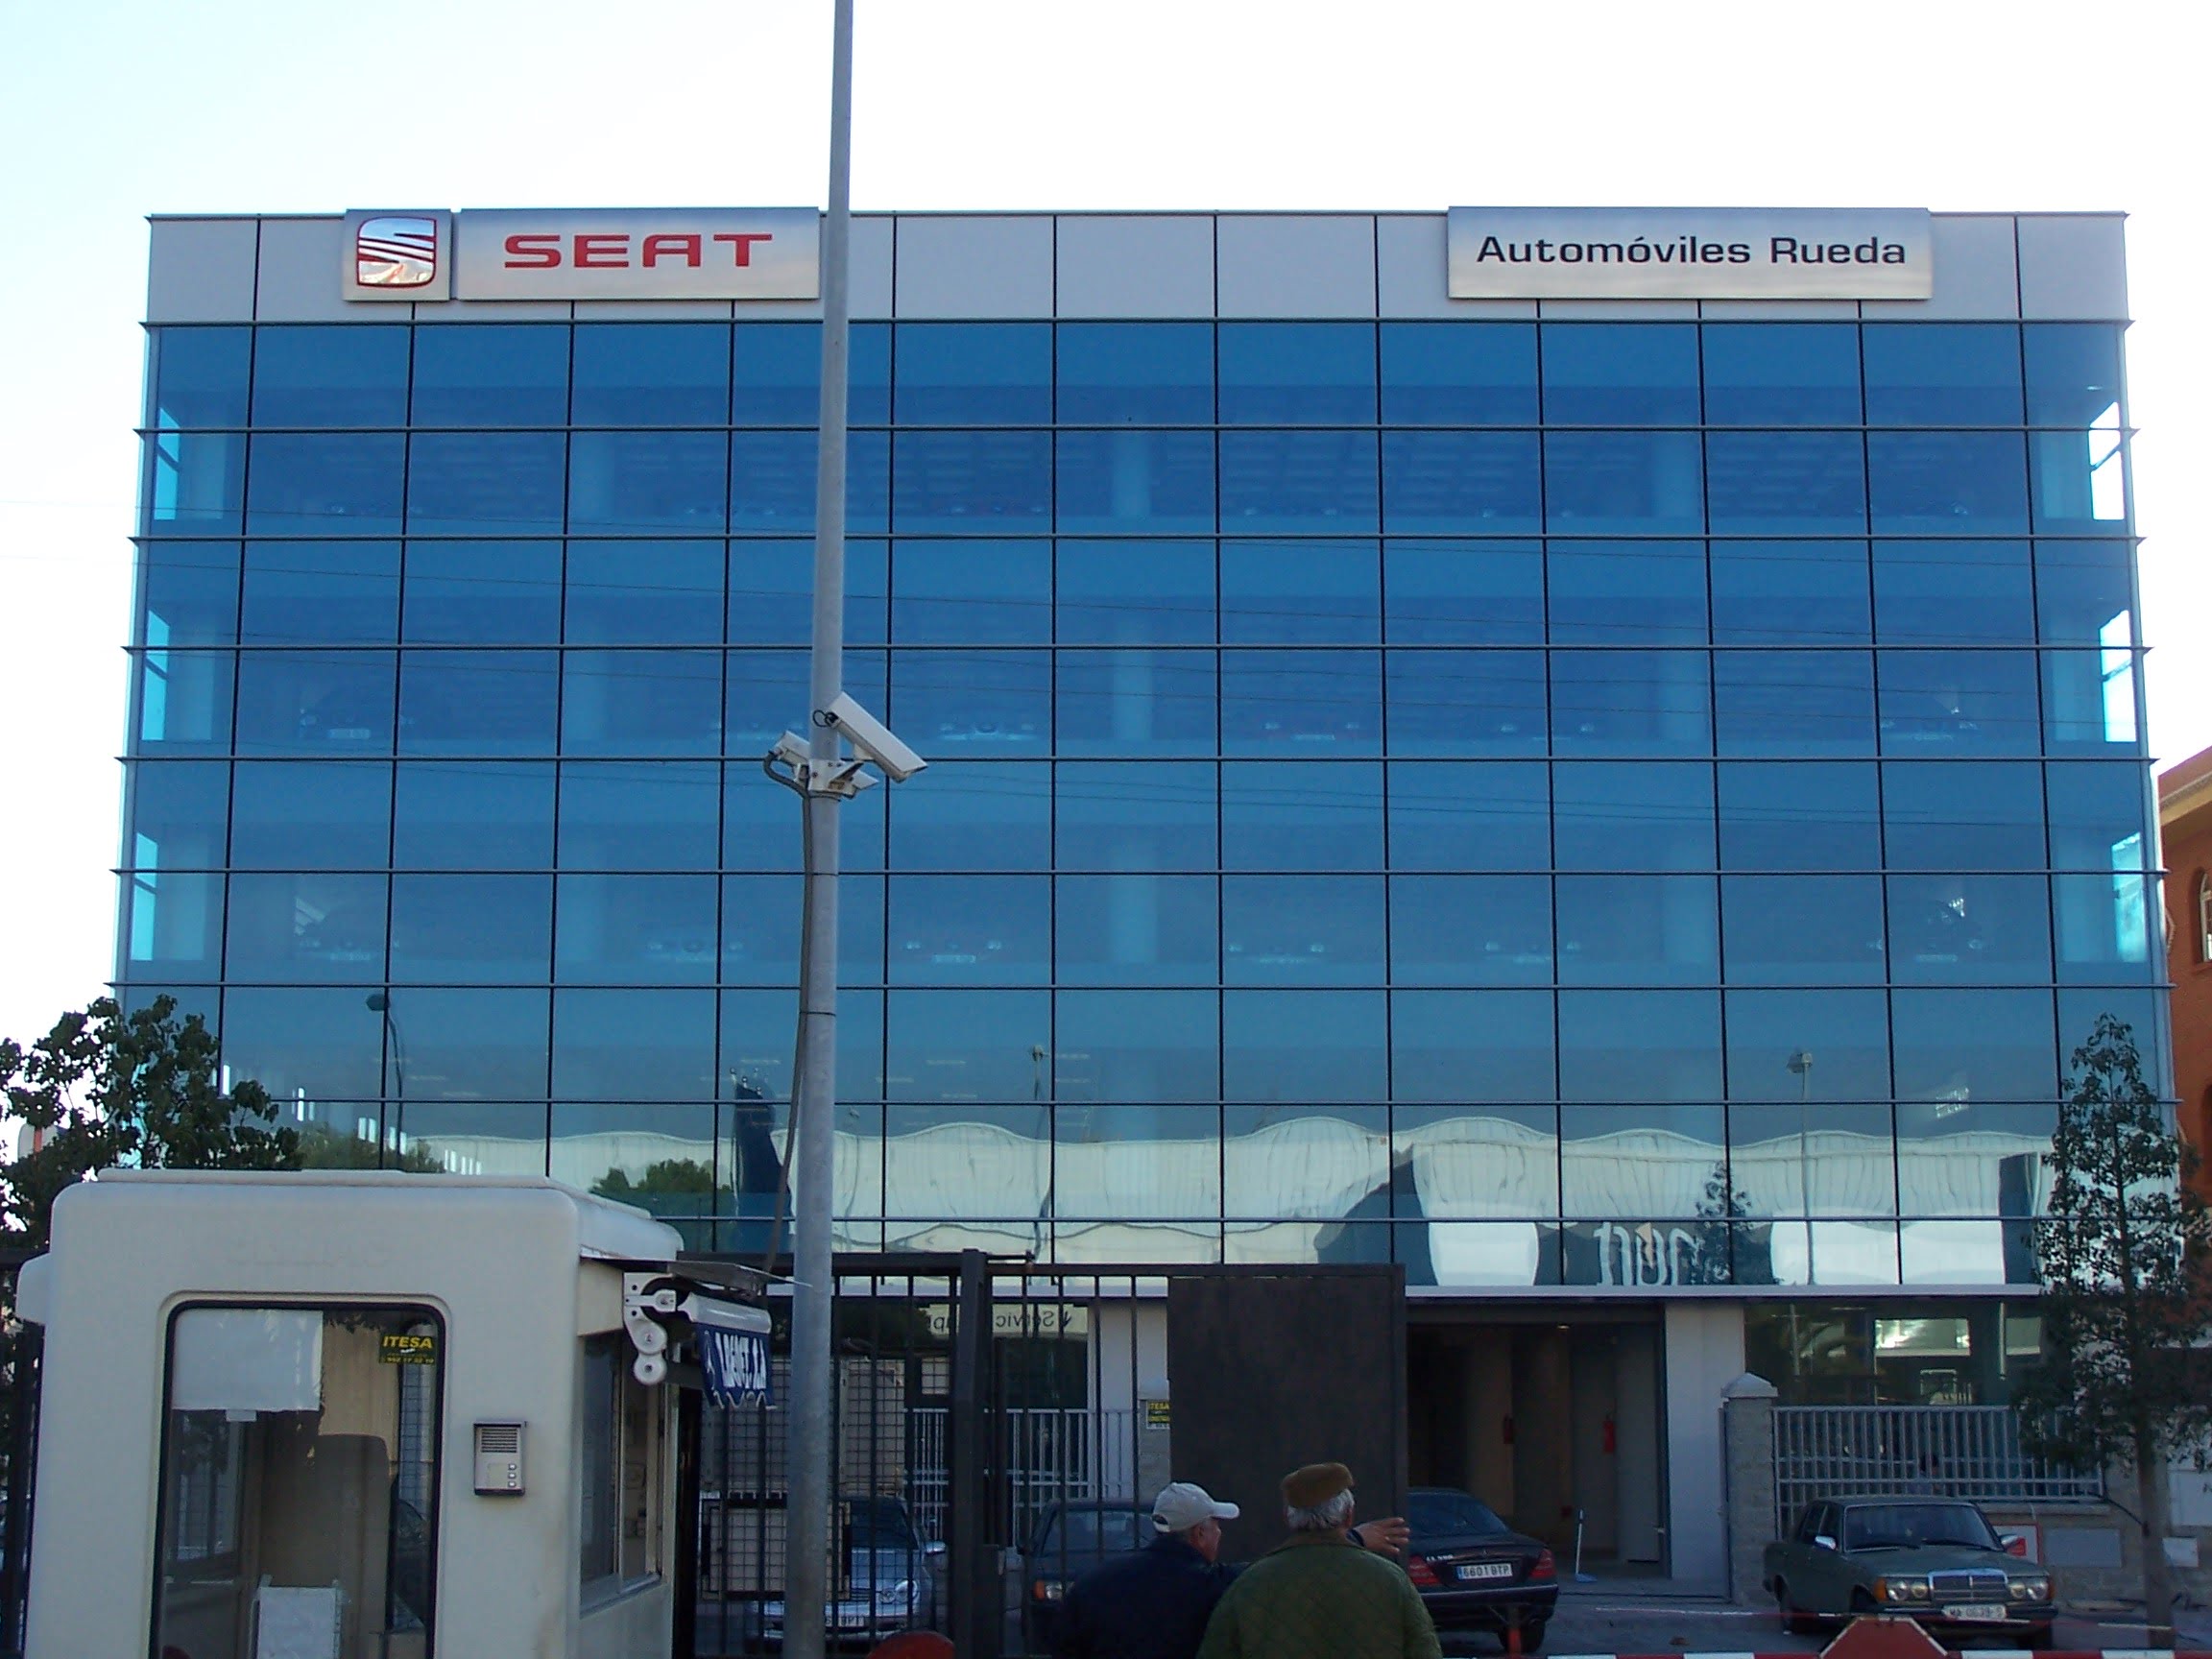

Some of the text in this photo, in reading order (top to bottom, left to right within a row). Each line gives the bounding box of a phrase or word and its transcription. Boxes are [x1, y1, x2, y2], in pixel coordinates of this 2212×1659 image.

[504, 234, 773, 268] SEAT
[1477, 236, 1906, 264] Automóviles Rueda
[383, 1335, 433, 1349] ITESA
